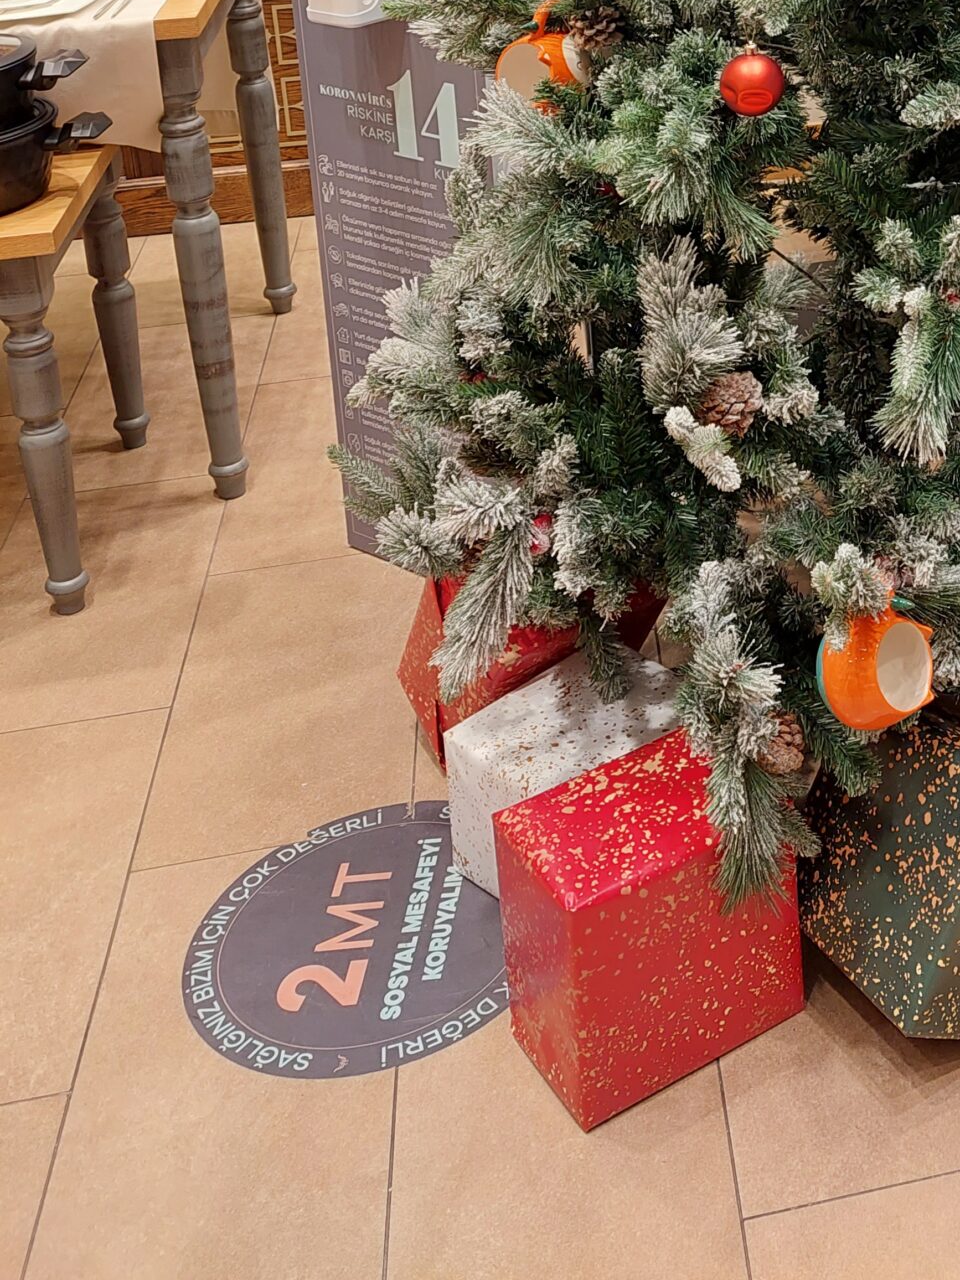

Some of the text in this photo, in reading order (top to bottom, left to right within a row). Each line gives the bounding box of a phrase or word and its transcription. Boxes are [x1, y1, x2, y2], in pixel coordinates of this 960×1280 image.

[319, 84, 393, 109] KORONAVİRÜS
[347, 103, 395, 126] RİSKİNE
[360, 124, 396, 144] KARŞI
[386, 69, 460, 169] 14
[185, 808, 383, 1071] SAĞLIĞINIZ BİZİM İÇİN ÇOK DEĞERLİ
[276, 862, 393, 1013] 2MT
[379, 837, 442, 1021] SOSYAL MESAFEYİ
[421, 864, 464, 982] KORUYALIM
[381, 996, 499, 1068] DEĞERLİ
